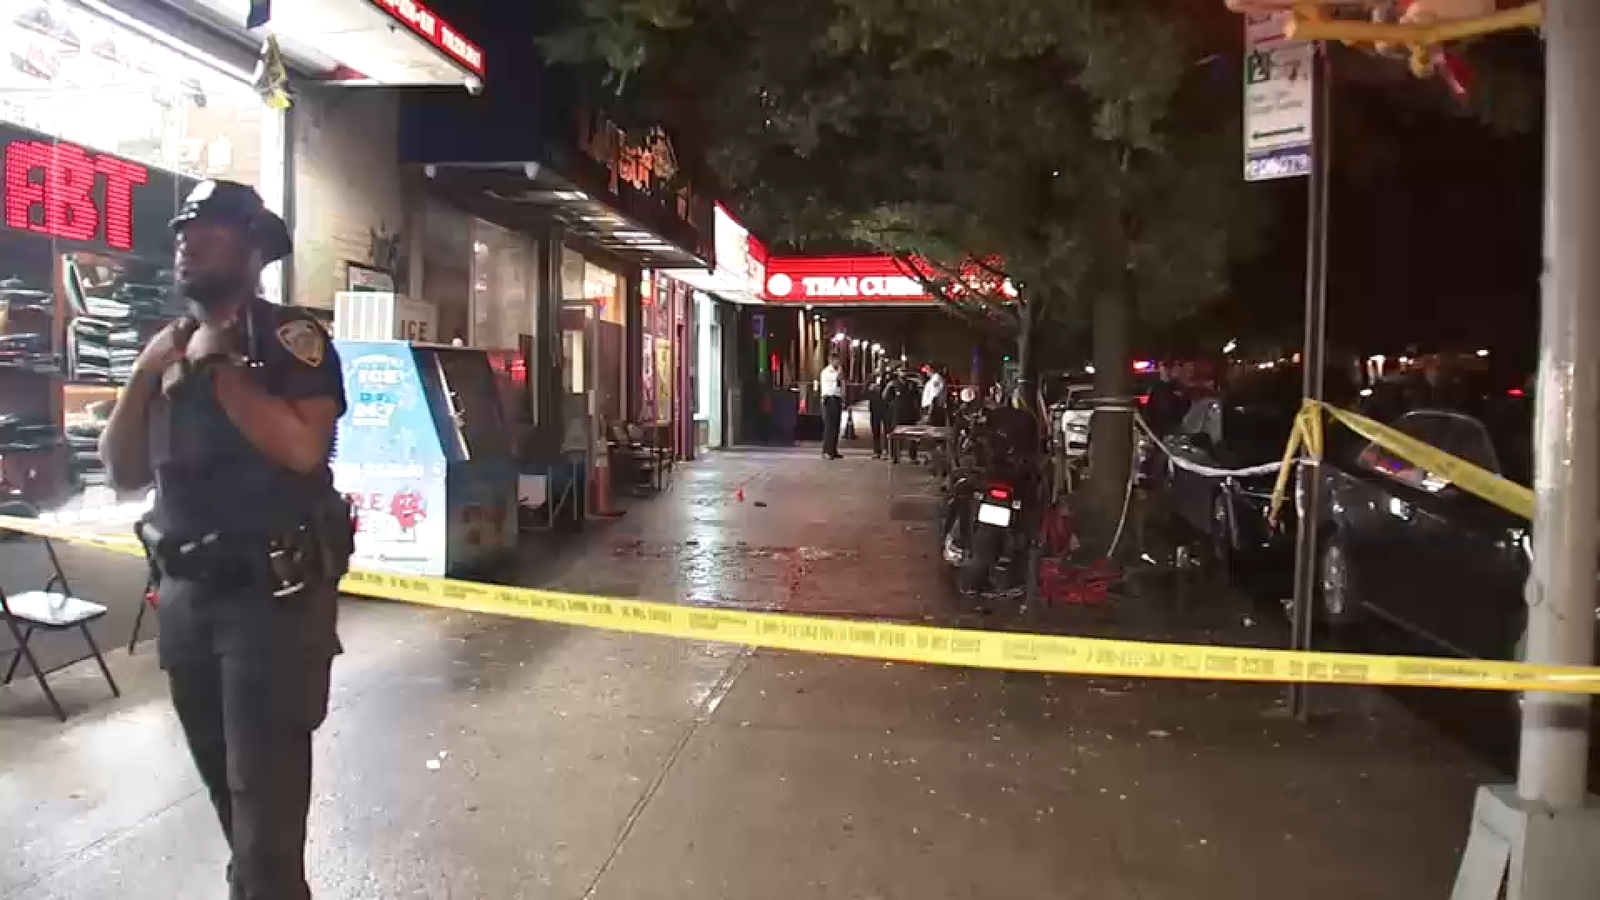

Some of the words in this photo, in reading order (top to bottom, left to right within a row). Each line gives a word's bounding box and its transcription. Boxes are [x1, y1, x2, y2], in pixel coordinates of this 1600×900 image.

[6, 140, 148, 250] EBT
[802, 276, 858, 297] THAI
[401, 319, 428, 342] ICE
